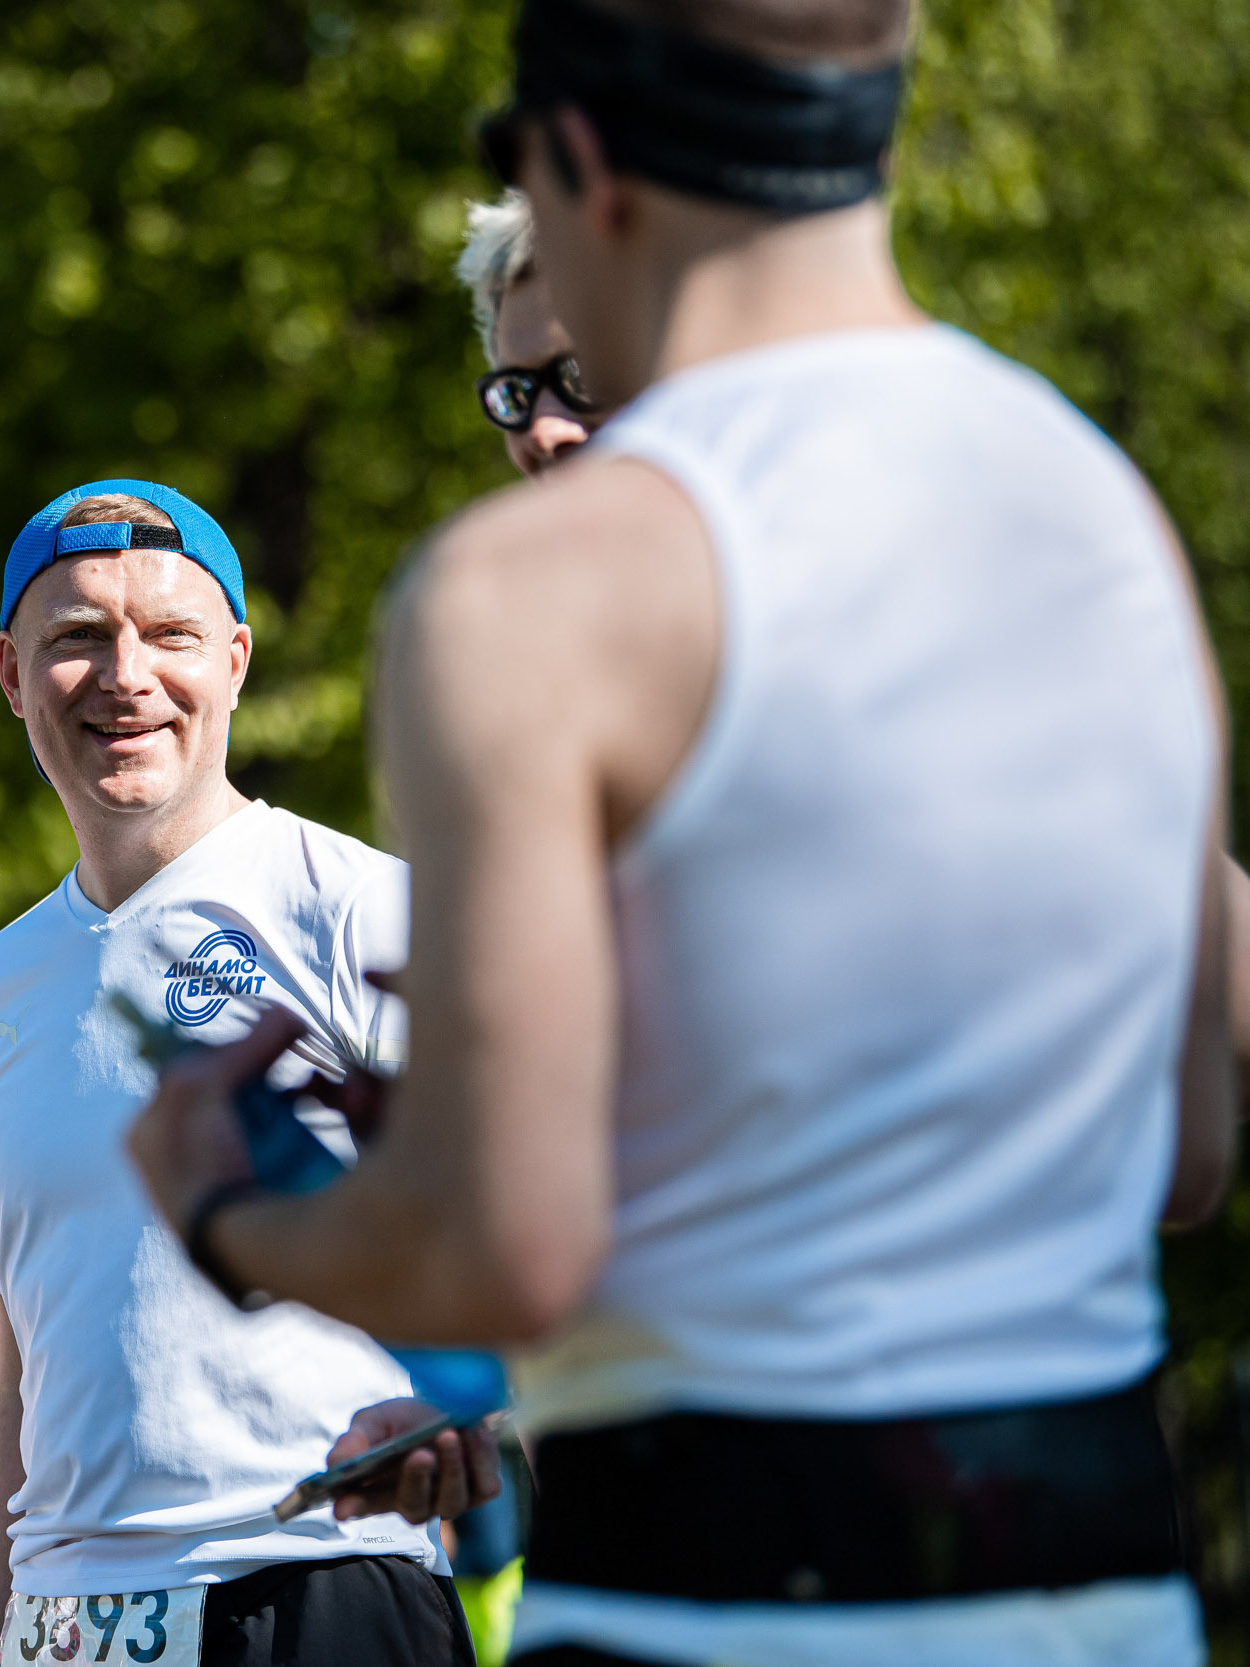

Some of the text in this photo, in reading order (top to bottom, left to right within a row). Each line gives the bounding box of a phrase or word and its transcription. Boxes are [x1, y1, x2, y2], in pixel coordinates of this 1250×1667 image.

[164, 959, 257, 978] ДИНАМО
[187, 976, 266, 997] БЕЖИТ
[362, 1535, 396, 1545] DRYCELL
